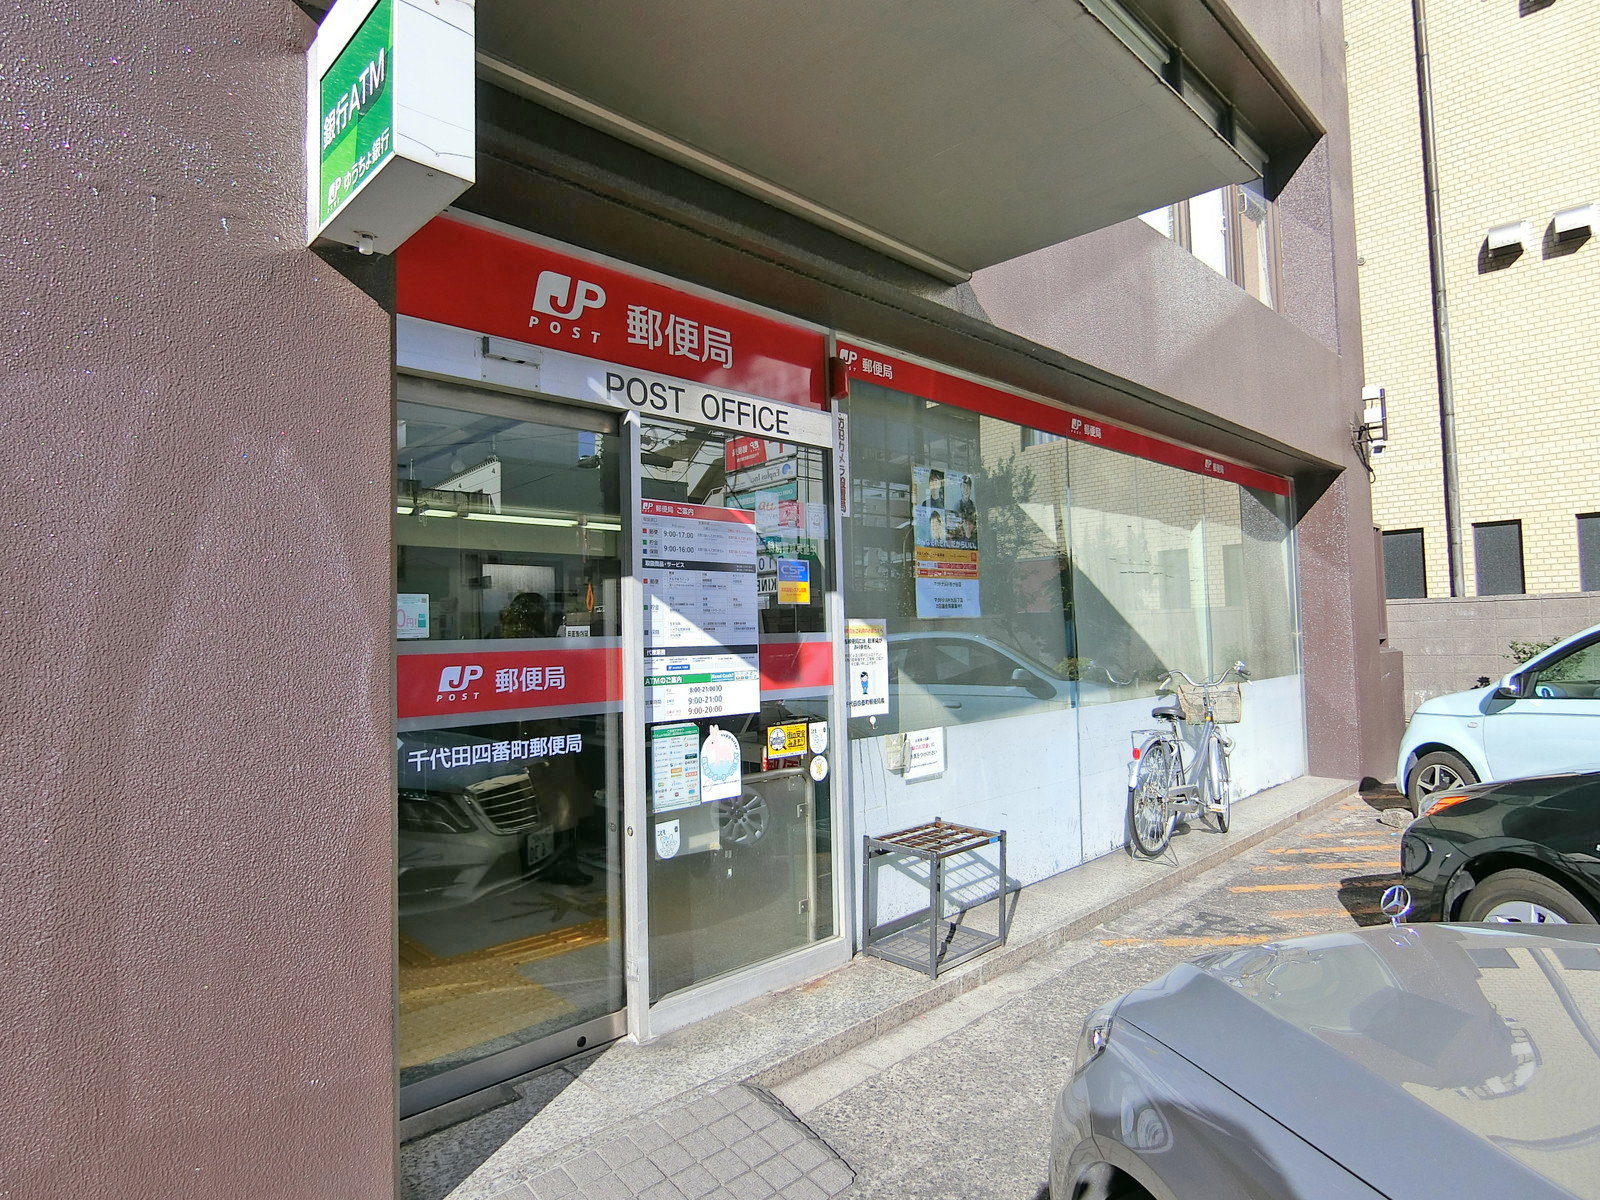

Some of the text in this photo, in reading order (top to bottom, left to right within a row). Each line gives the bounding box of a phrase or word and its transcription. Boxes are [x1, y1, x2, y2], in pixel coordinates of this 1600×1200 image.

[323, 48, 385, 150] 銀行ATM
[343, 127, 390, 191] ゆうちょ銀行
[528, 316, 601, 343] POST
[626, 304, 734, 370] 郵便局
[862, 357, 893, 380] 郵便局
[606, 371, 790, 436] POST OFFICE
[1084, 423, 1102, 439] 郵便局
[655, 504, 674, 514] 郵便局
[676, 507, 695, 516] ご案内
[663, 530, 694, 539] 9:00-17:00
[663, 545, 695, 554] 9:00-16:00
[780, 564, 806, 575] CSP
[495, 665, 566, 694] 郵便局
[644, 675, 683, 685] ATMのご案内
[436, 691, 481, 702] POST
[688, 694, 723, 705] 9:00-21:00
[688, 705, 723, 716] 9:00-20:00
[407, 733, 583, 772] 千代田四番町郵便局
